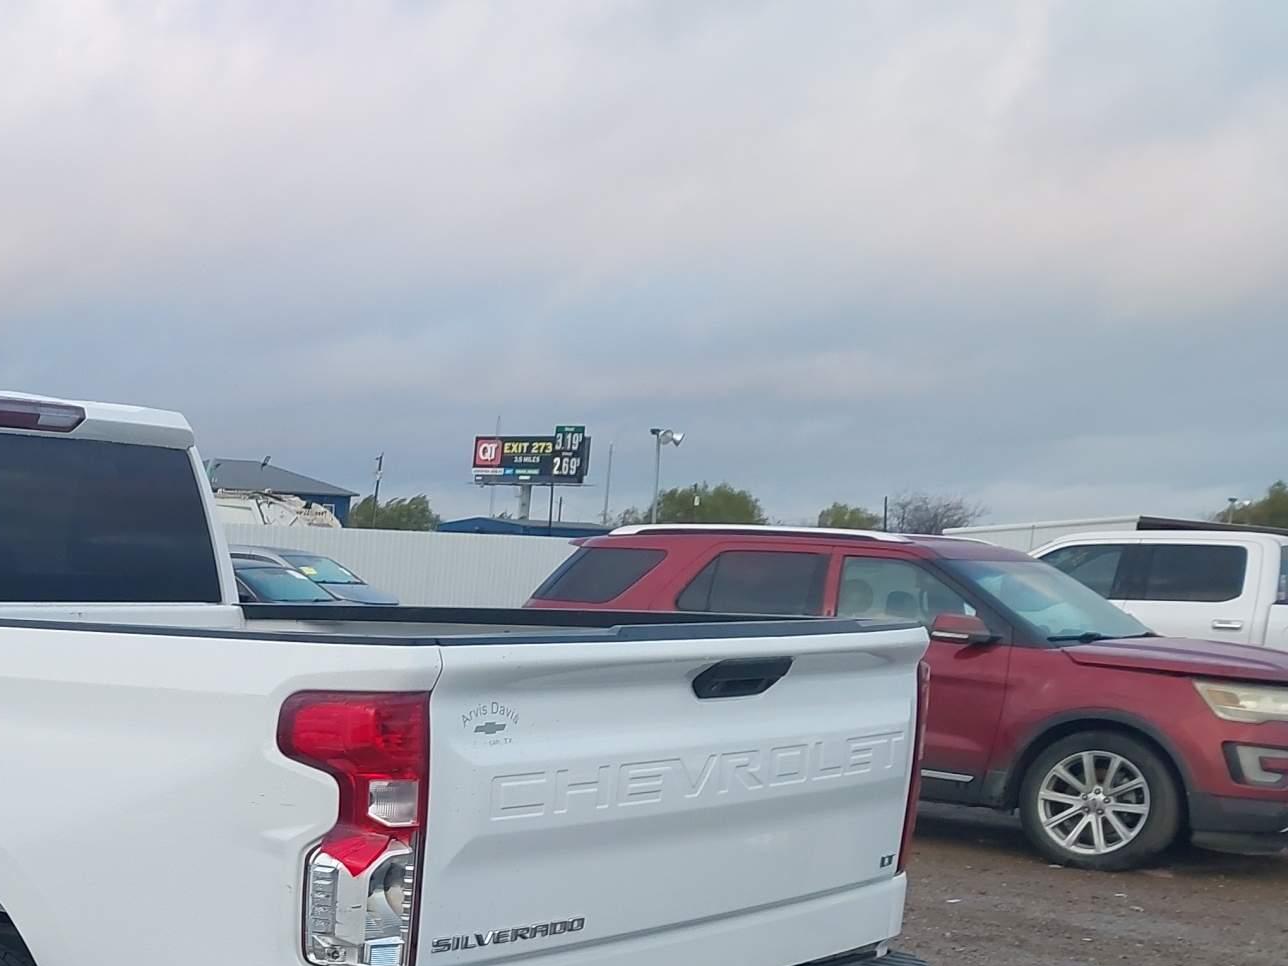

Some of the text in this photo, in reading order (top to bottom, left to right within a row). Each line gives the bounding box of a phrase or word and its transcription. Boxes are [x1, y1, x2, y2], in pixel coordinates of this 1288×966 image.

[478, 443, 498, 461] QT
[503, 442, 552, 453] EXIT 273
[461, 703, 488, 729] Arvis
[490, 730, 906, 822] CHEVROLET
[880, 853, 896, 868] LT
[430, 916, 586, 954] SILVERADO
